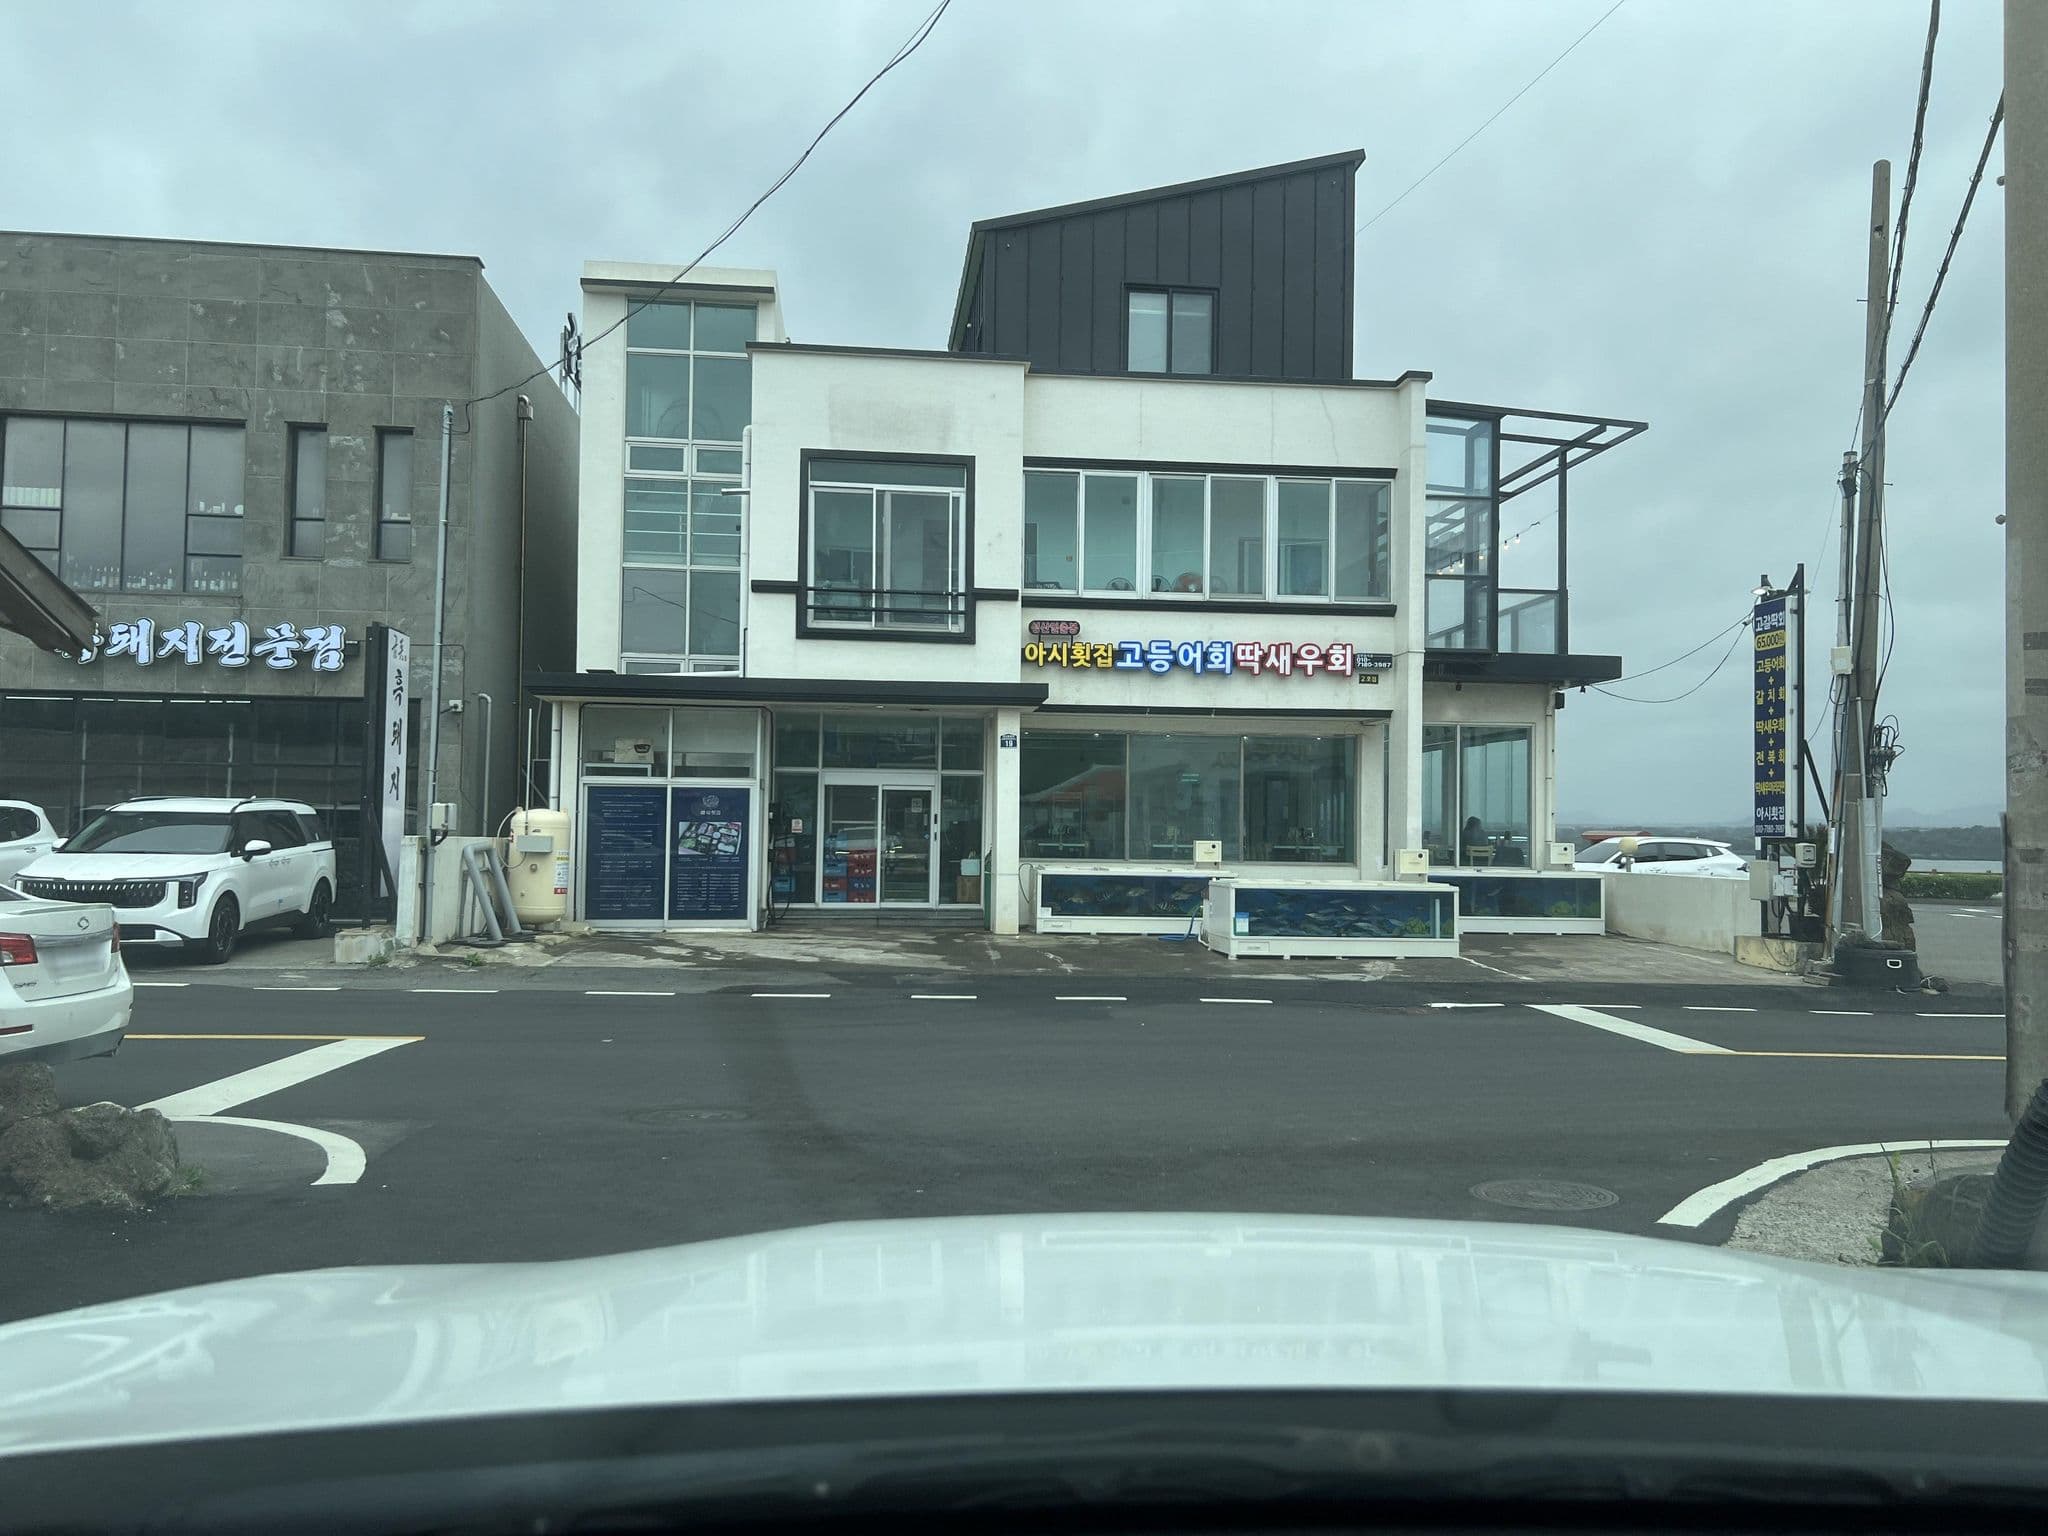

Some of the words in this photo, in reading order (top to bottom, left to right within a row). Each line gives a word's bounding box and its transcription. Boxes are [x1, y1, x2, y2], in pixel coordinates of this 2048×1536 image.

[55, 618, 346, 671] 돼지전문점
[1024, 641, 1114, 668] 아시횟집
[1116, 640, 1233, 677] 고등어회
[1234, 640, 1353, 677] 딱새우회
[1755, 655, 1785, 673] 고등어회
[1755, 717, 1785, 735] 딱새우회
[1756, 805, 1785, 821] 아시횟집
